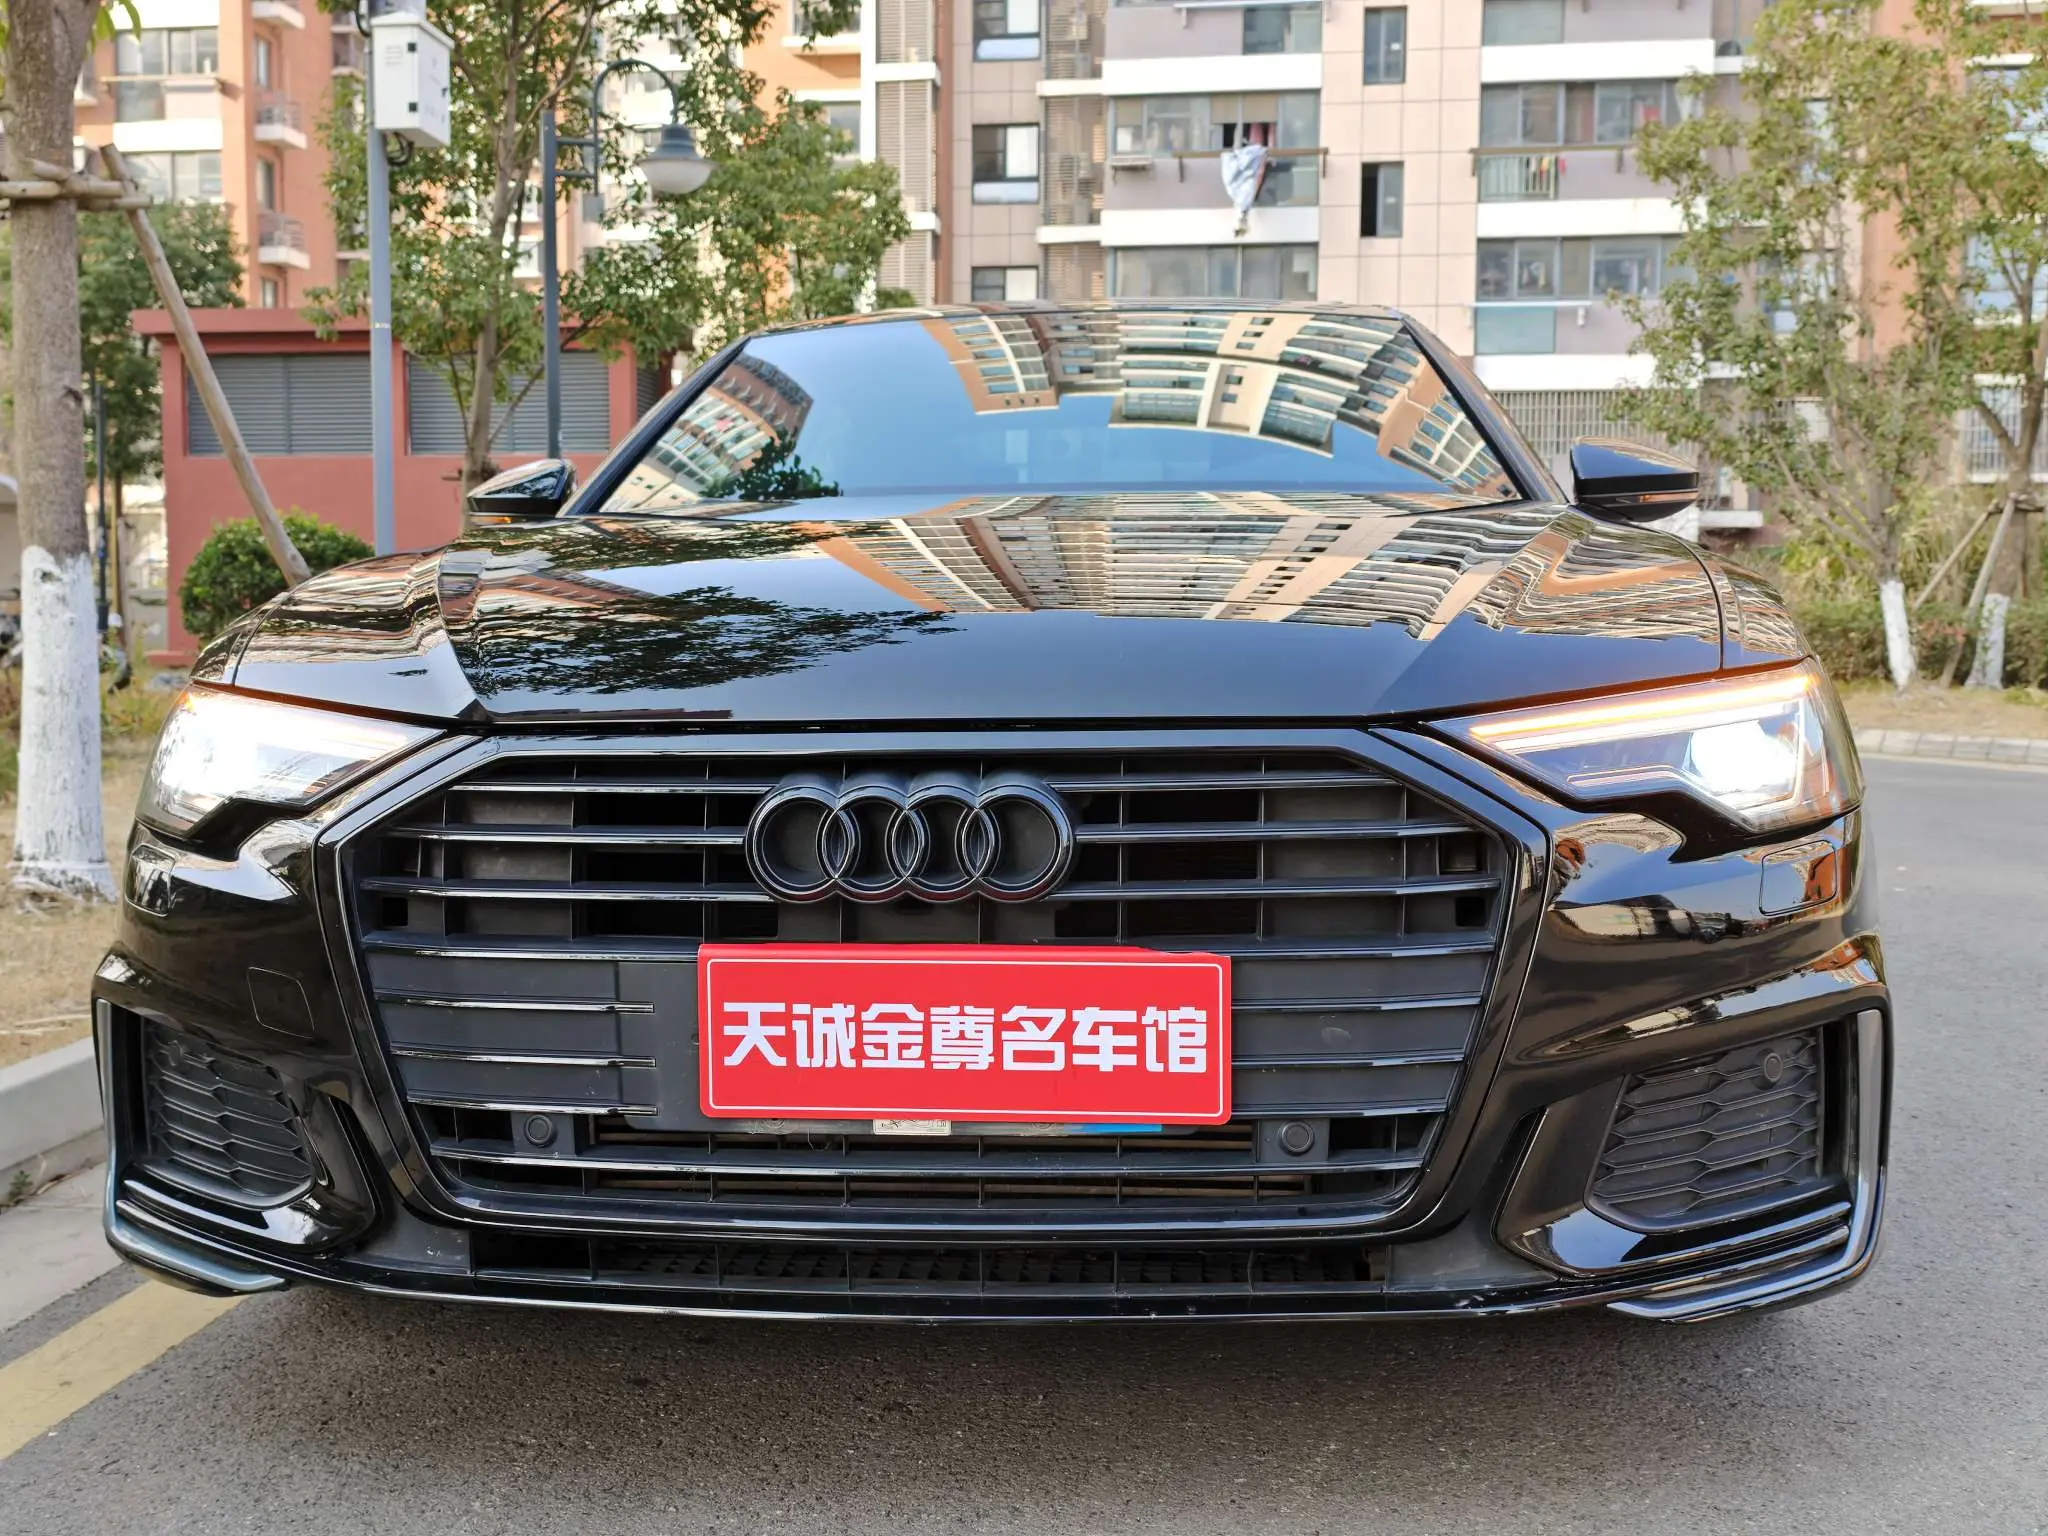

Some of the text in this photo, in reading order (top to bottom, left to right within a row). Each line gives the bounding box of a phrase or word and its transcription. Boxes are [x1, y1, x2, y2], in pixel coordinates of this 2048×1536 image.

[723, 1002, 1207, 1073] 天诚金尊名车馆
